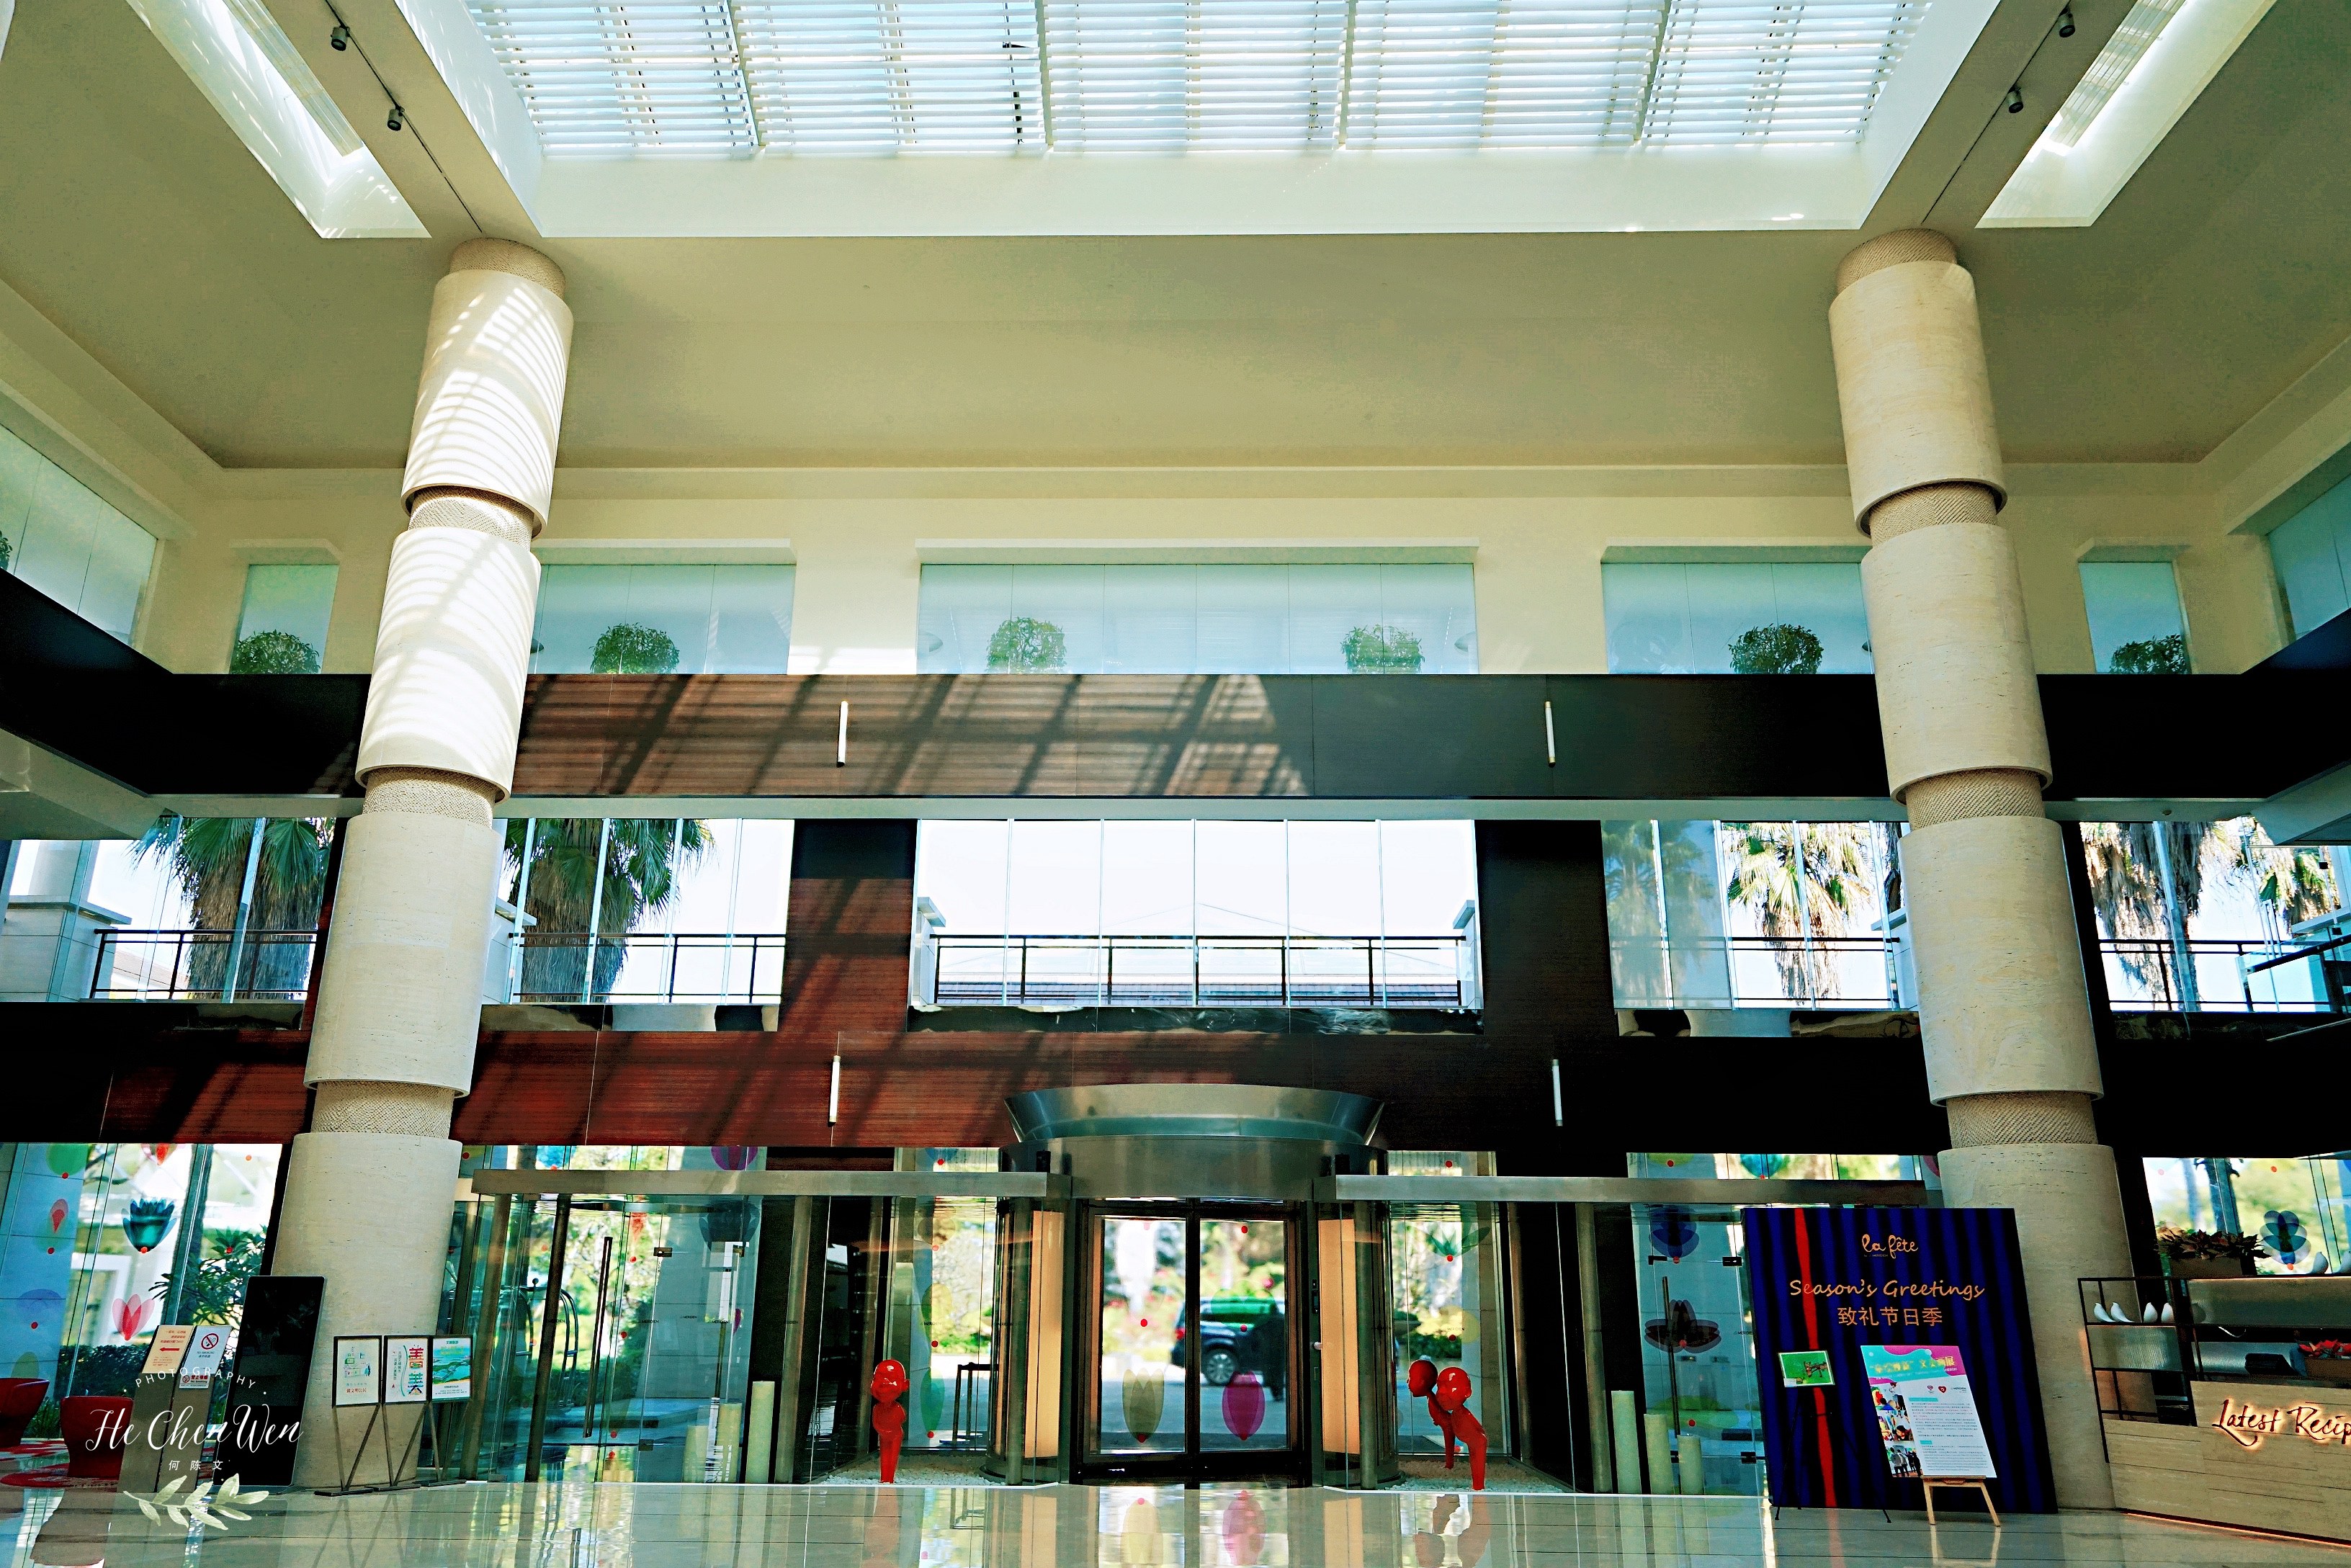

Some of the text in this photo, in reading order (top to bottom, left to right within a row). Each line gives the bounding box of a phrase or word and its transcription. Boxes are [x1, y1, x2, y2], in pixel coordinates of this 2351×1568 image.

[1862, 1234, 1919, 1259] la fête
[1789, 1278, 1985, 1301] Season's Greetings
[1837, 1307, 1943, 1326] 致礼节日季
[2211, 1399, 2281, 1447] Latest
